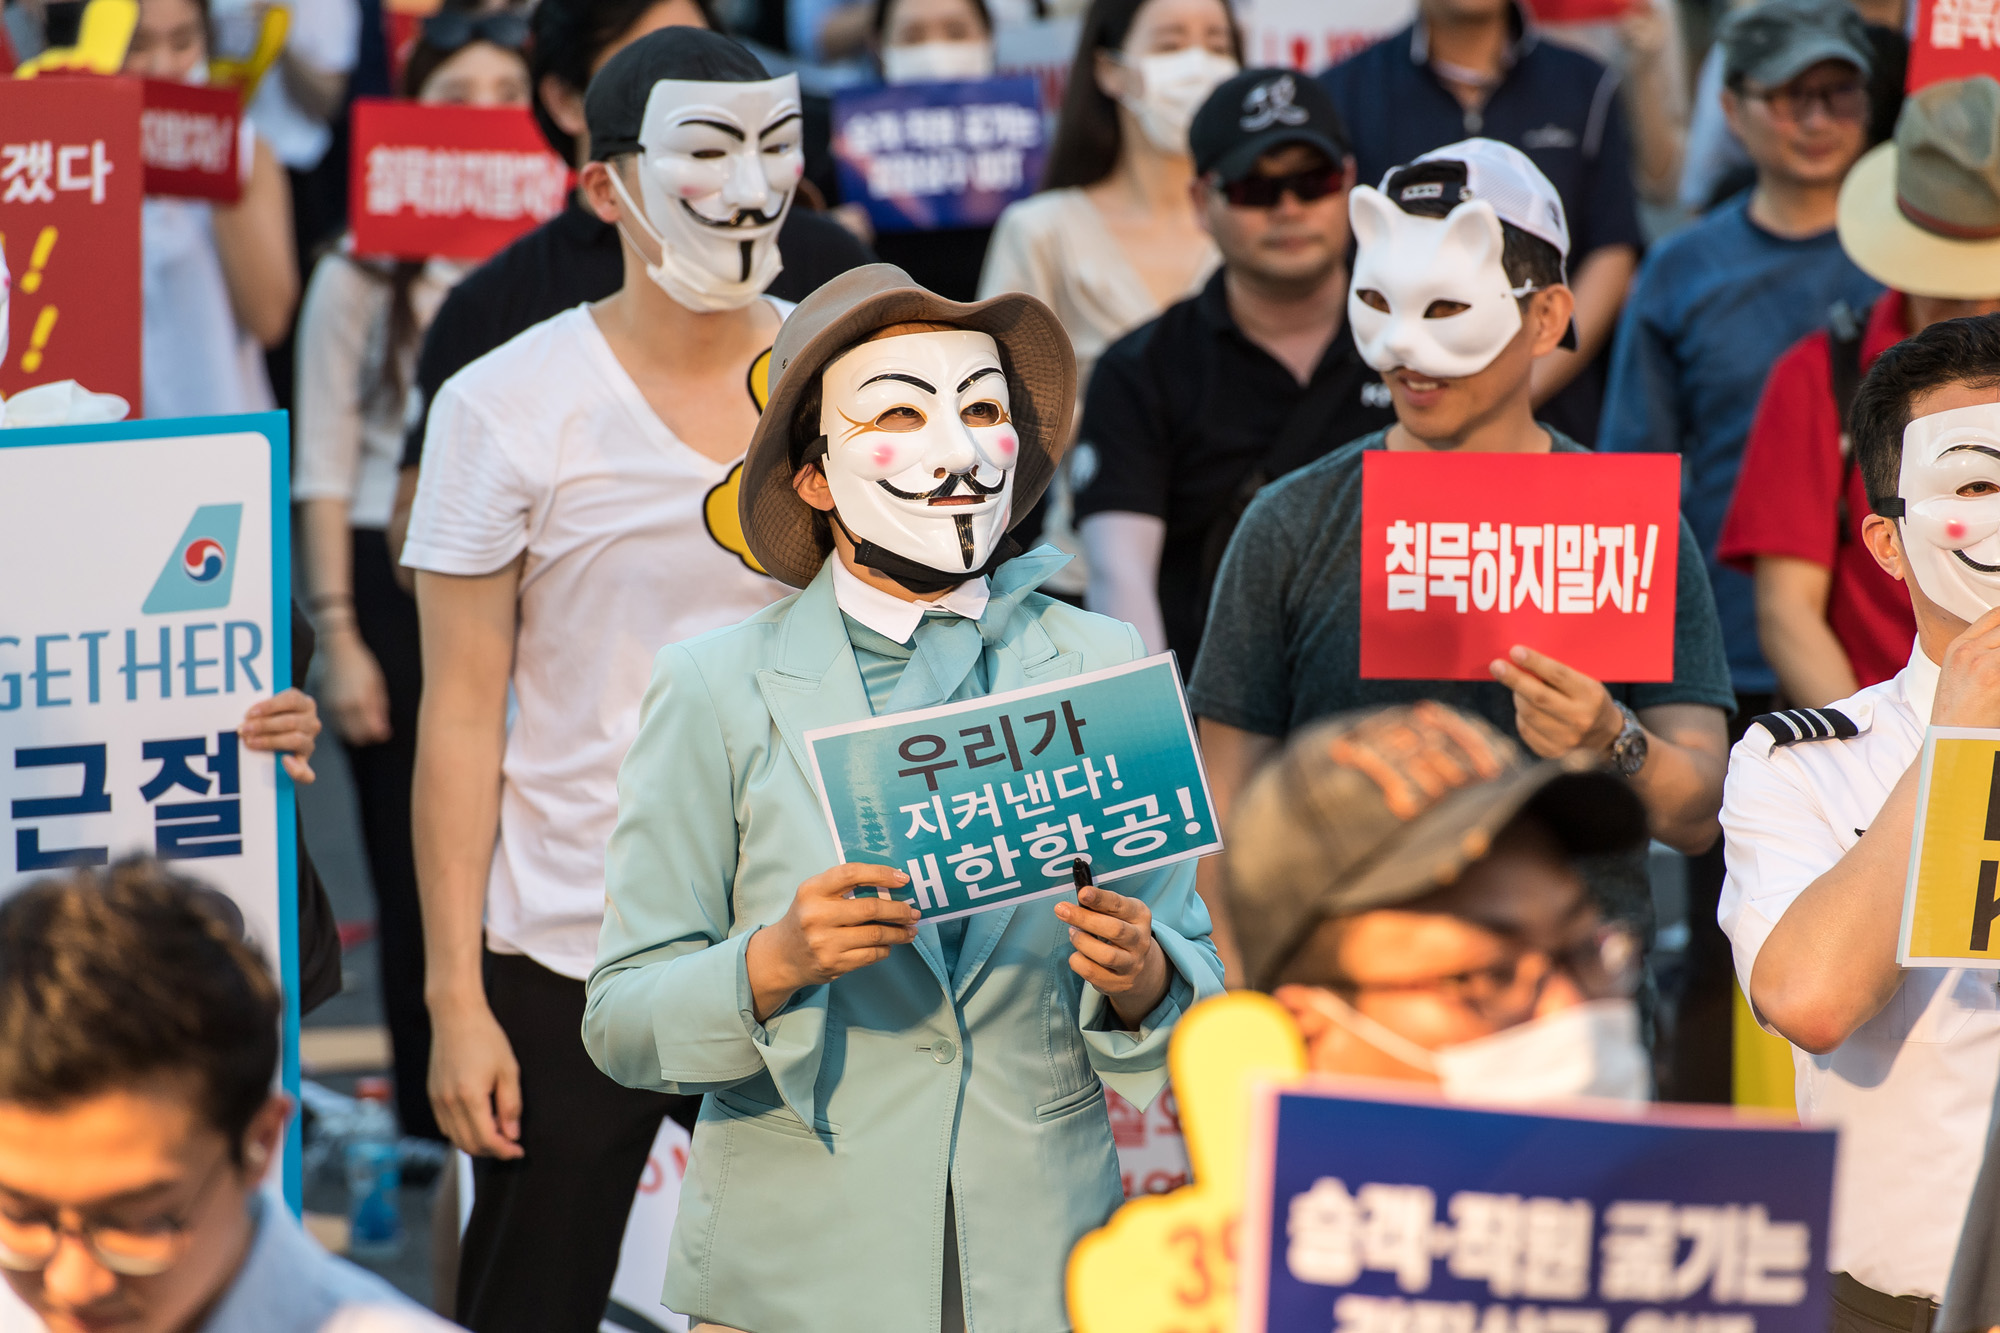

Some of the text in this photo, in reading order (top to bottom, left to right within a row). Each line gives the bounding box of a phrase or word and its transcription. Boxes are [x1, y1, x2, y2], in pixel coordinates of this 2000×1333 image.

[0, 139, 114, 204] 겠다
[1385, 520, 1659, 614] 침묵하지말자!
[898, 700, 1087, 792] 우리가
[11, 729, 243, 872] 근절
[899, 754, 1124, 841] 지켜낸다!
